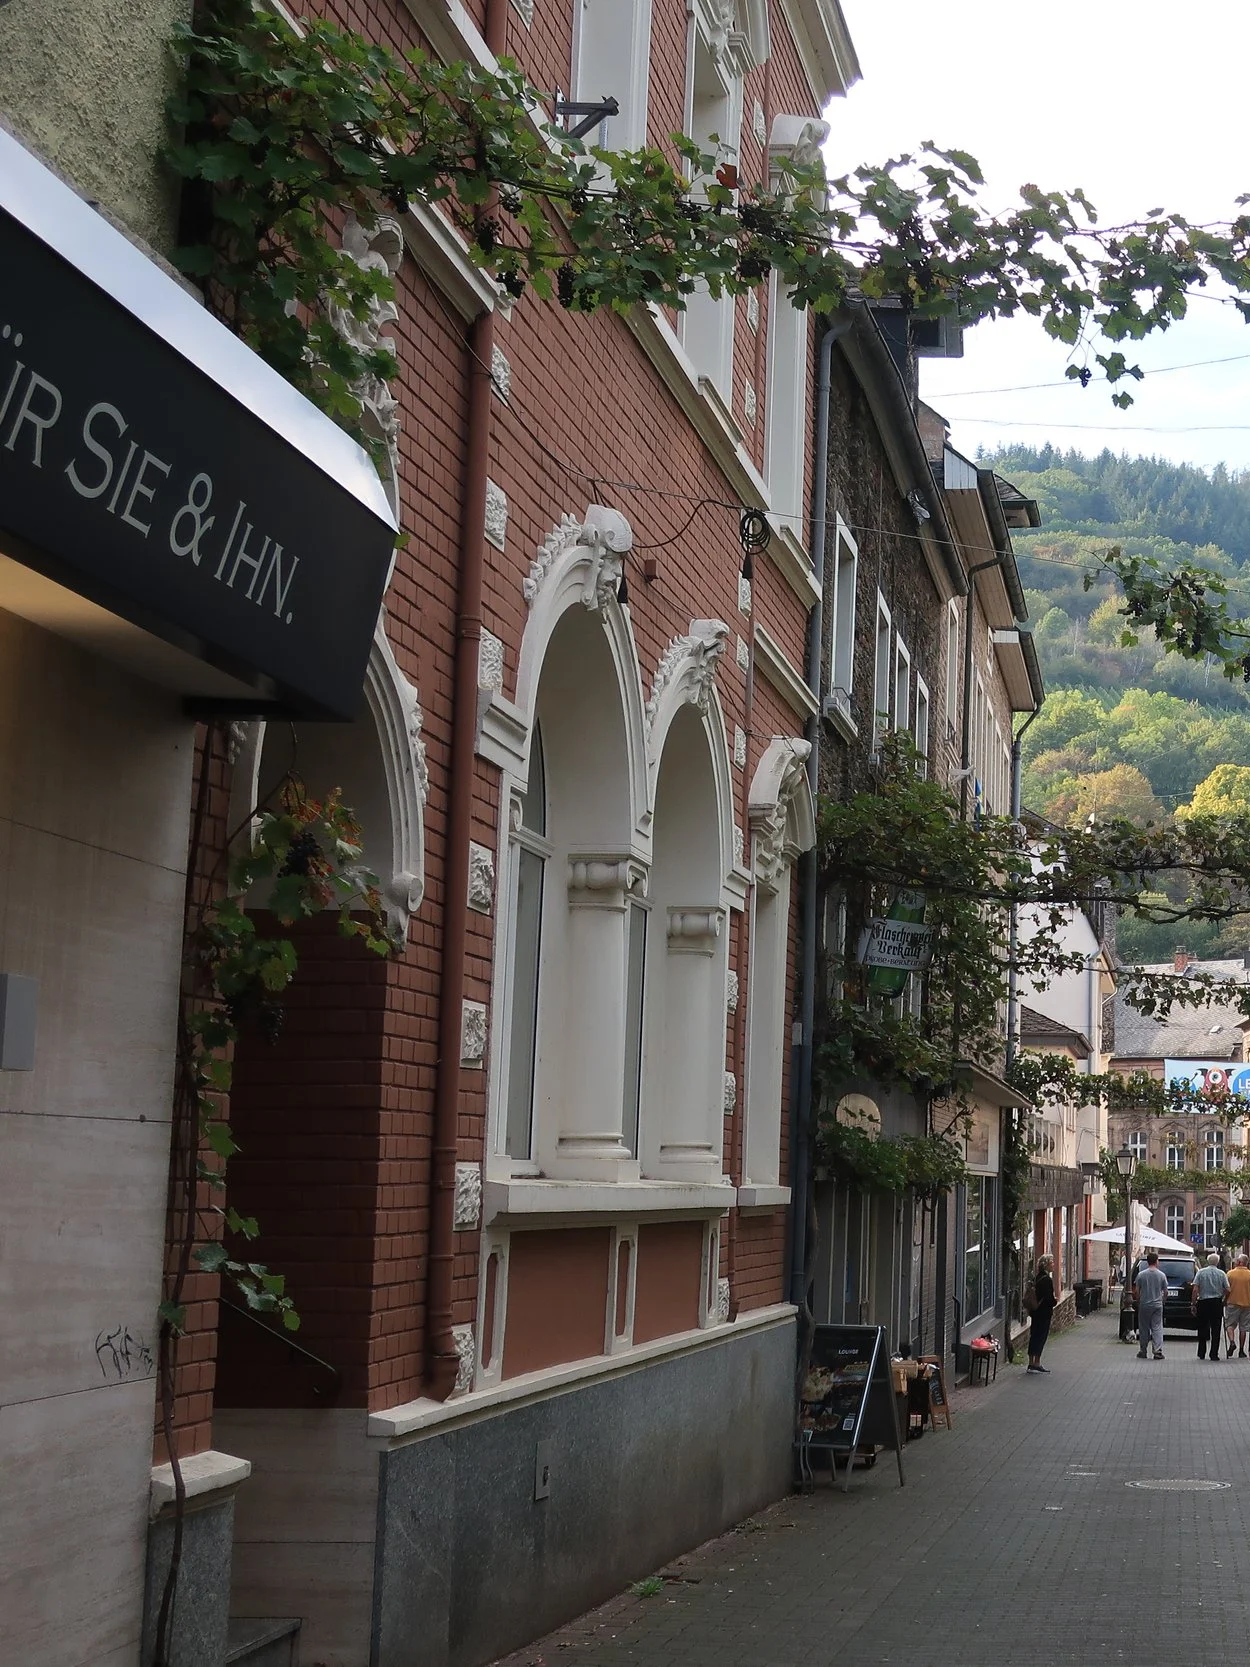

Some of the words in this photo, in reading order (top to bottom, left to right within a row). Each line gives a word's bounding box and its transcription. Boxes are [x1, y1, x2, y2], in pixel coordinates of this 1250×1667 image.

[64, 402, 173, 540] SIE
[169, 472, 215, 566] &
[213, 500, 301, 626] IHN.
